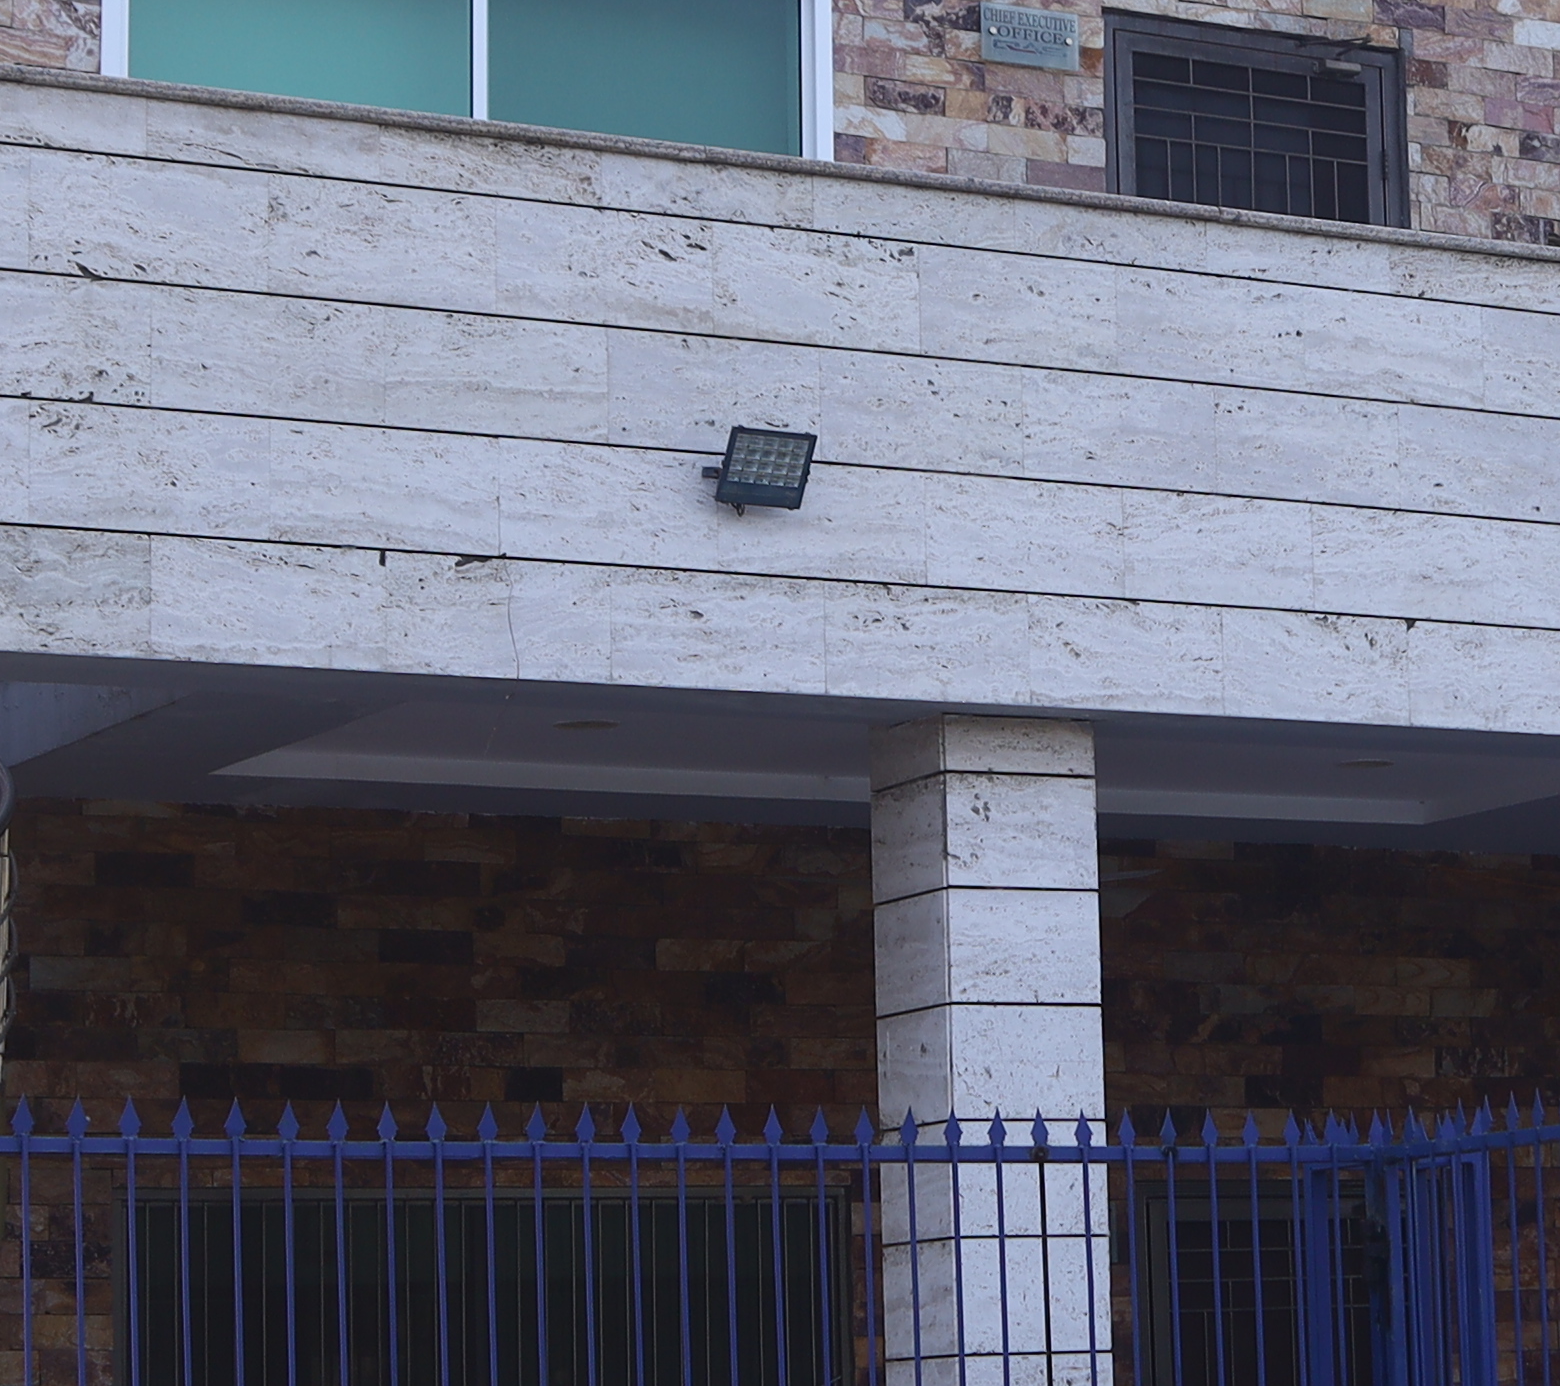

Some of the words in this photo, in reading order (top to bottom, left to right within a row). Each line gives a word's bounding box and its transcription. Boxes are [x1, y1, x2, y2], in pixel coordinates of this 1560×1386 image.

[983, 7, 1016, 25] CHIEF
[1017, 11, 1077, 33] EXECUTIVE
[997, 25, 1065, 46] OFFICE
